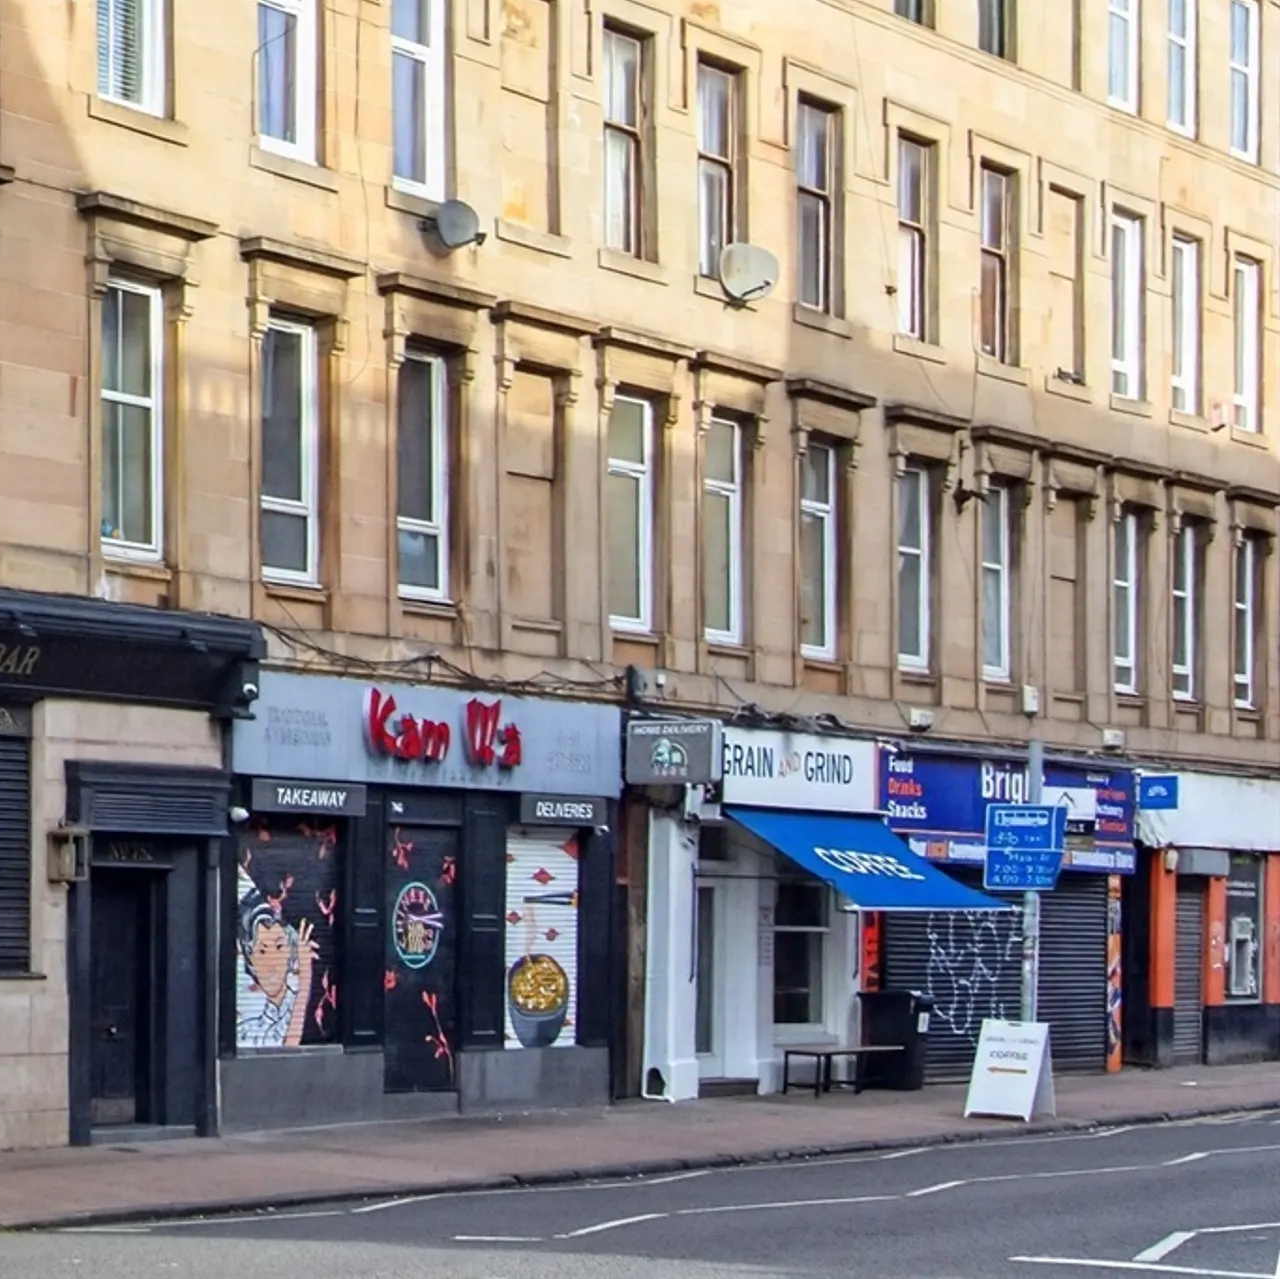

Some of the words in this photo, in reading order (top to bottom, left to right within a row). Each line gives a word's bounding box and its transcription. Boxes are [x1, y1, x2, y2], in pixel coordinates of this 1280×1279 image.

[363, 687, 451, 761] Kam
[461, 697, 523, 768] Wa
[723, 744, 773, 779] GRAIN
[803, 750, 853, 784] GRIND
[888, 756, 913, 773] Food
[888, 778, 923, 797] Drinks
[277, 788, 347, 808] TAKEAWAY
[536, 801, 593, 819] DELIVERIES
[888, 800, 928, 819] Snacks
[813, 847, 926, 880] COFFEE
